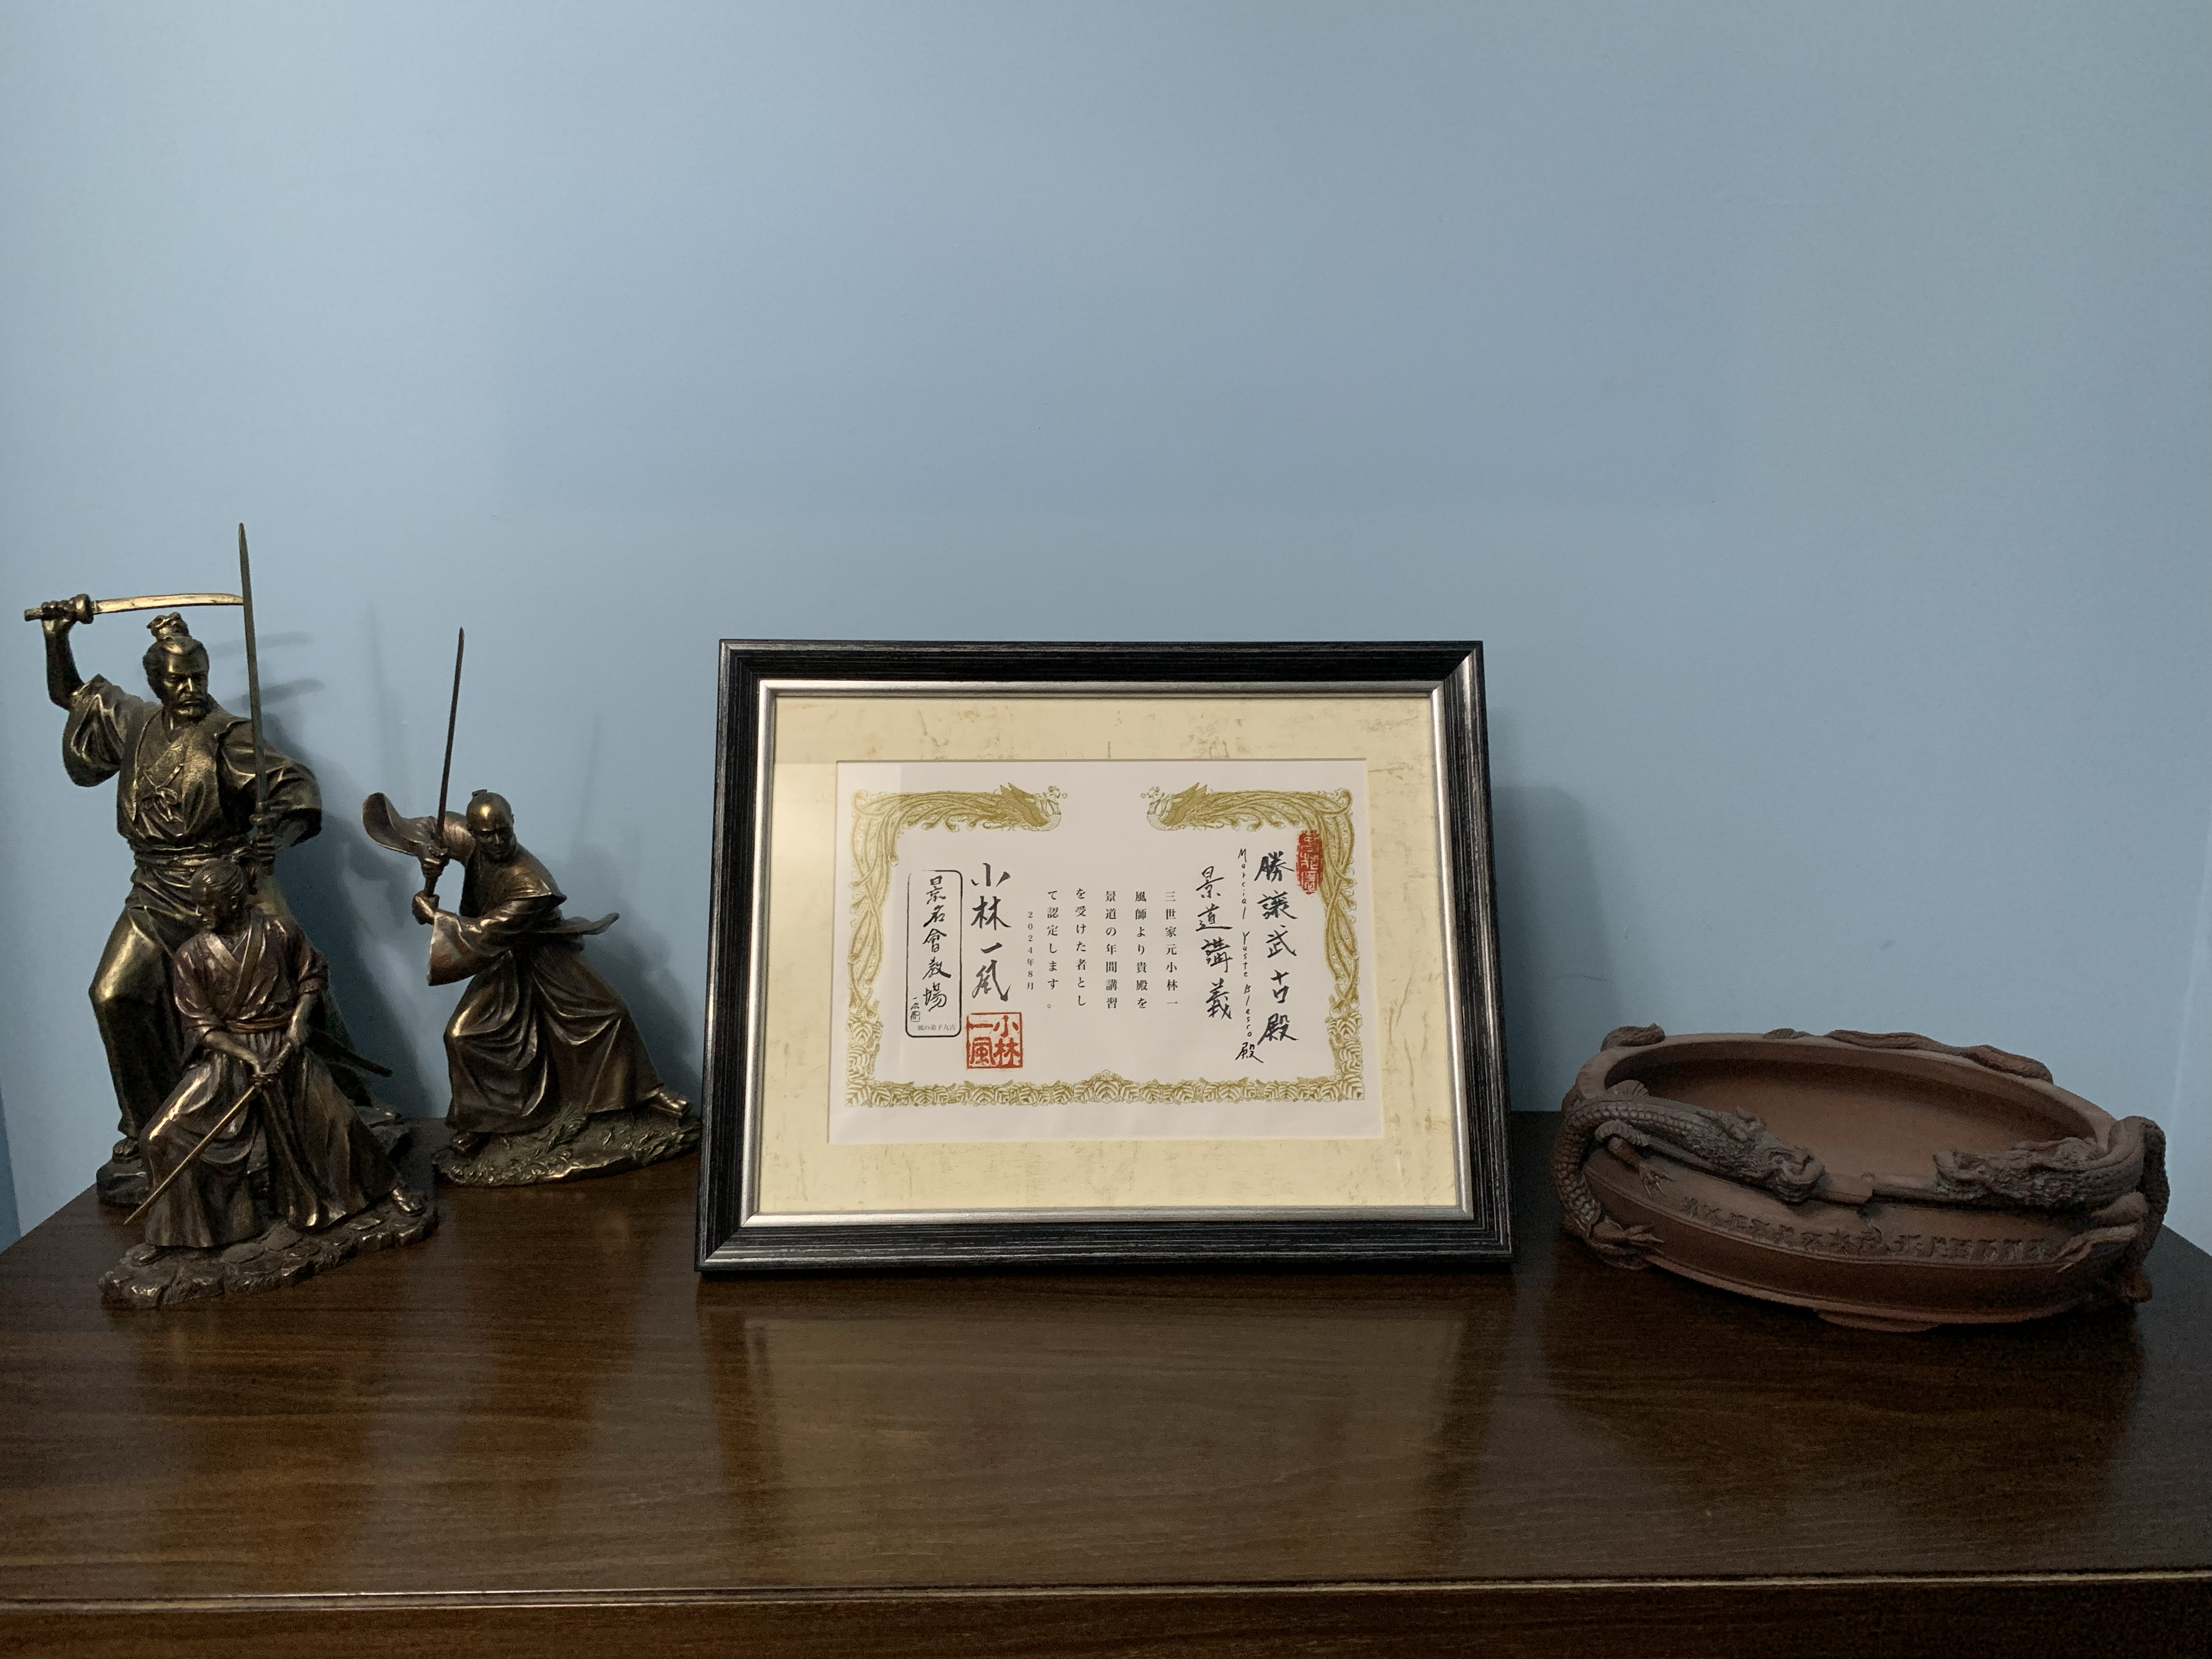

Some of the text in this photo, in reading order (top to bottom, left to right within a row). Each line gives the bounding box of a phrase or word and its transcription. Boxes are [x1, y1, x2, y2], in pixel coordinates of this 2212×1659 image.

[1237, 848, 1248, 920] Marcial
[1026, 911, 1035, 990] 2024年8月
[1047, 890, 1059, 1009] て認定します。
[1075, 888, 1087, 1006] を受けた者とし
[1105, 890, 1118, 1009] 景道の年間講習
[1135, 891, 1148, 1009] 風師より貴殿を
[1164, 891, 1178, 1005] 三世家元小林一
[1196, 866, 1233, 1020] 景道講義
[1242, 930, 1250, 977] Yuste
[1235, 1042, 1264, 1063] 殿
